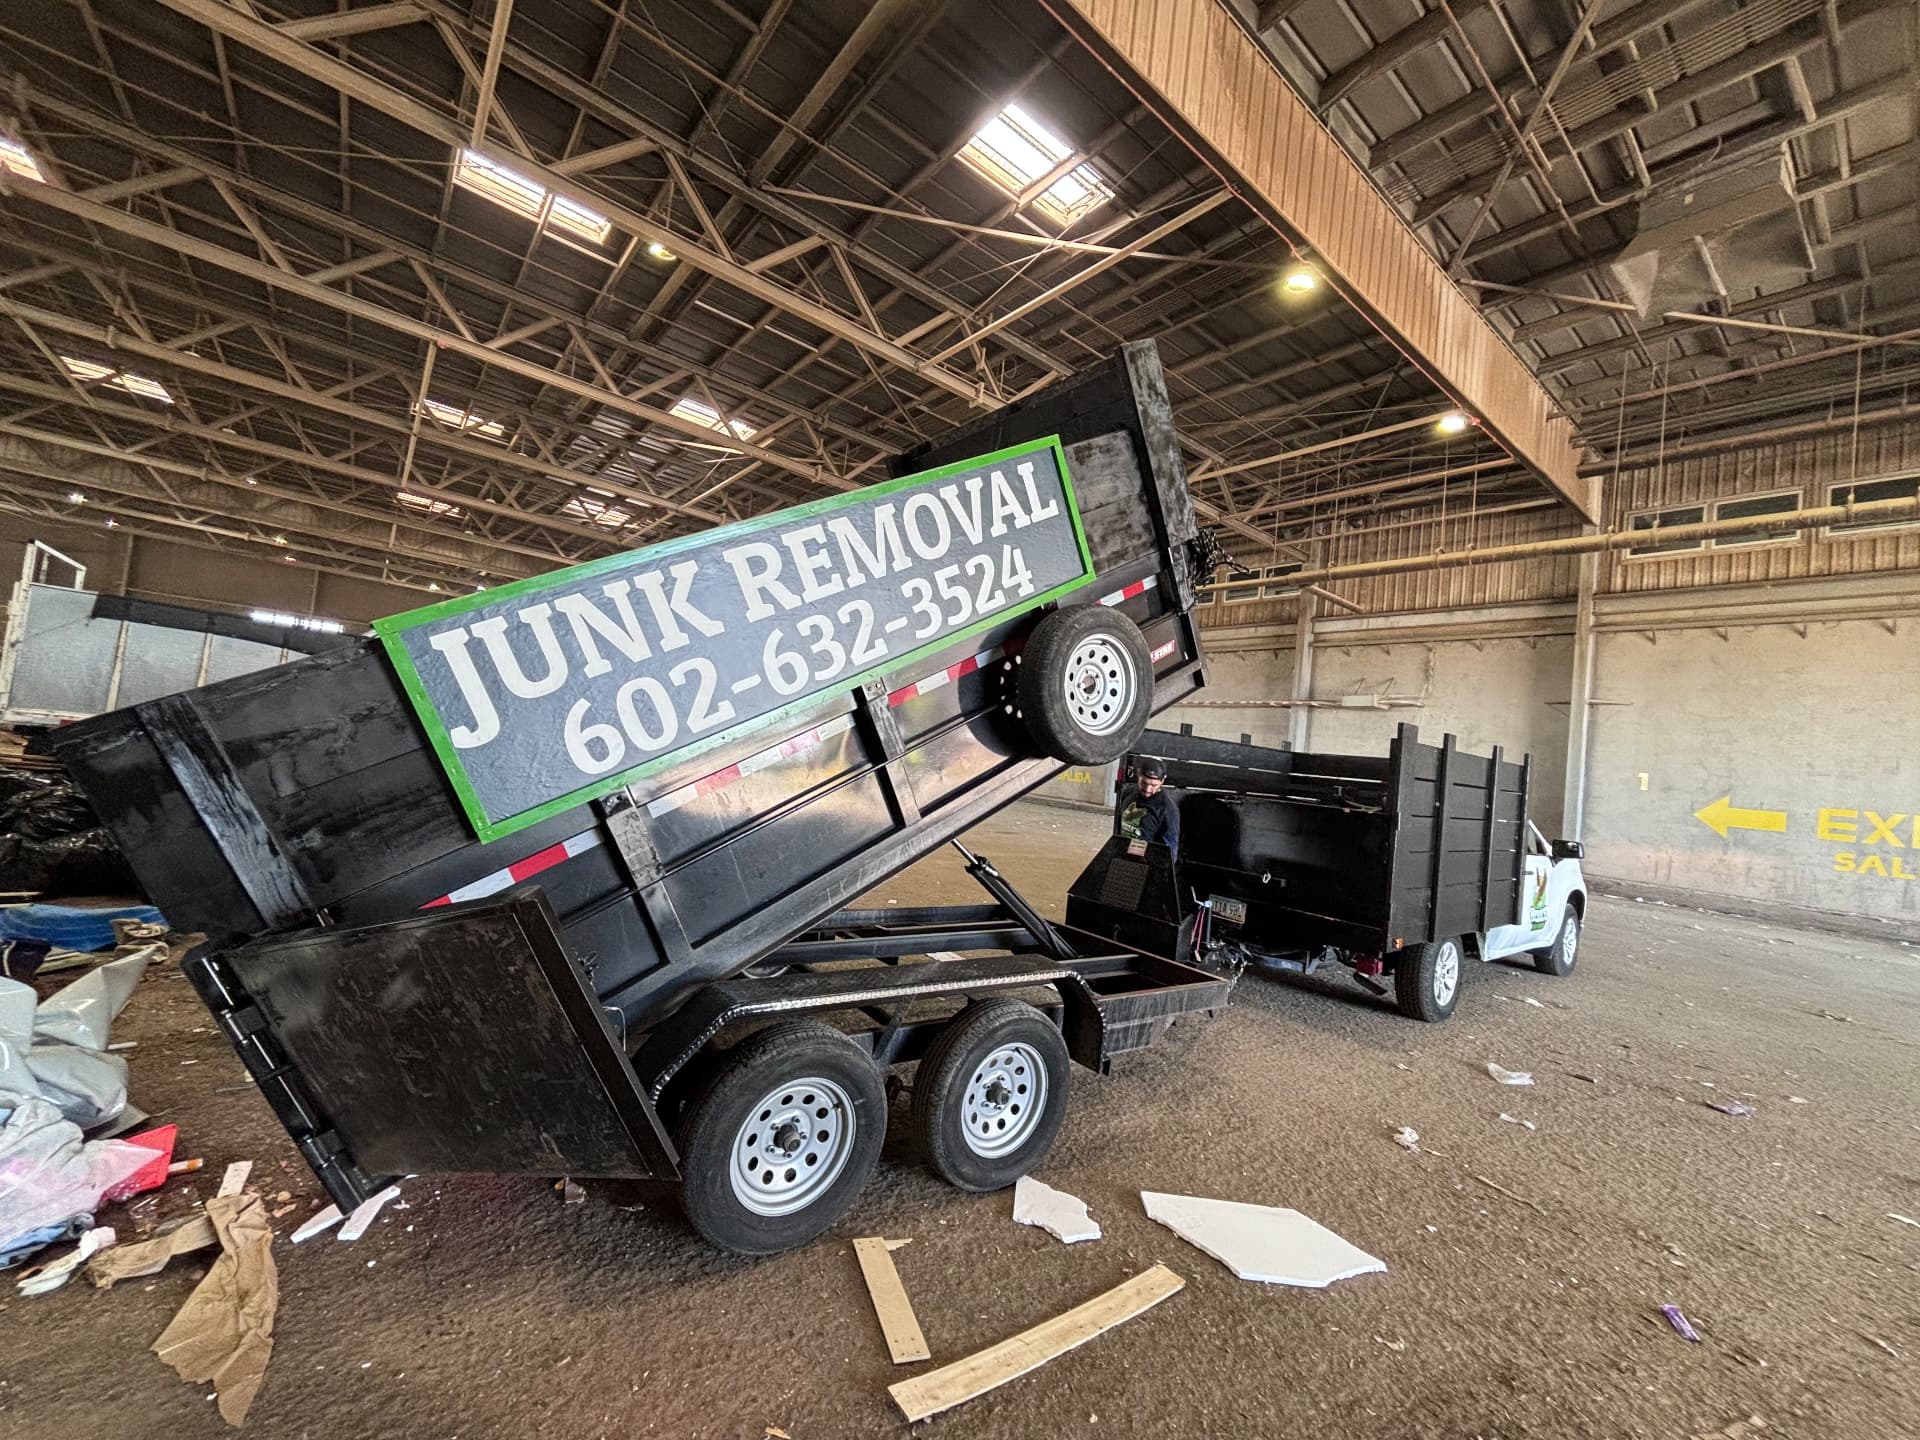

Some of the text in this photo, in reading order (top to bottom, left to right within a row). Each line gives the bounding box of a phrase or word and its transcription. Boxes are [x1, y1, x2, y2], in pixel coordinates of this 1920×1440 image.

[430, 462, 1060, 750] JUNK REMOVAL
[563, 544, 1034, 776] 602-632-3524
